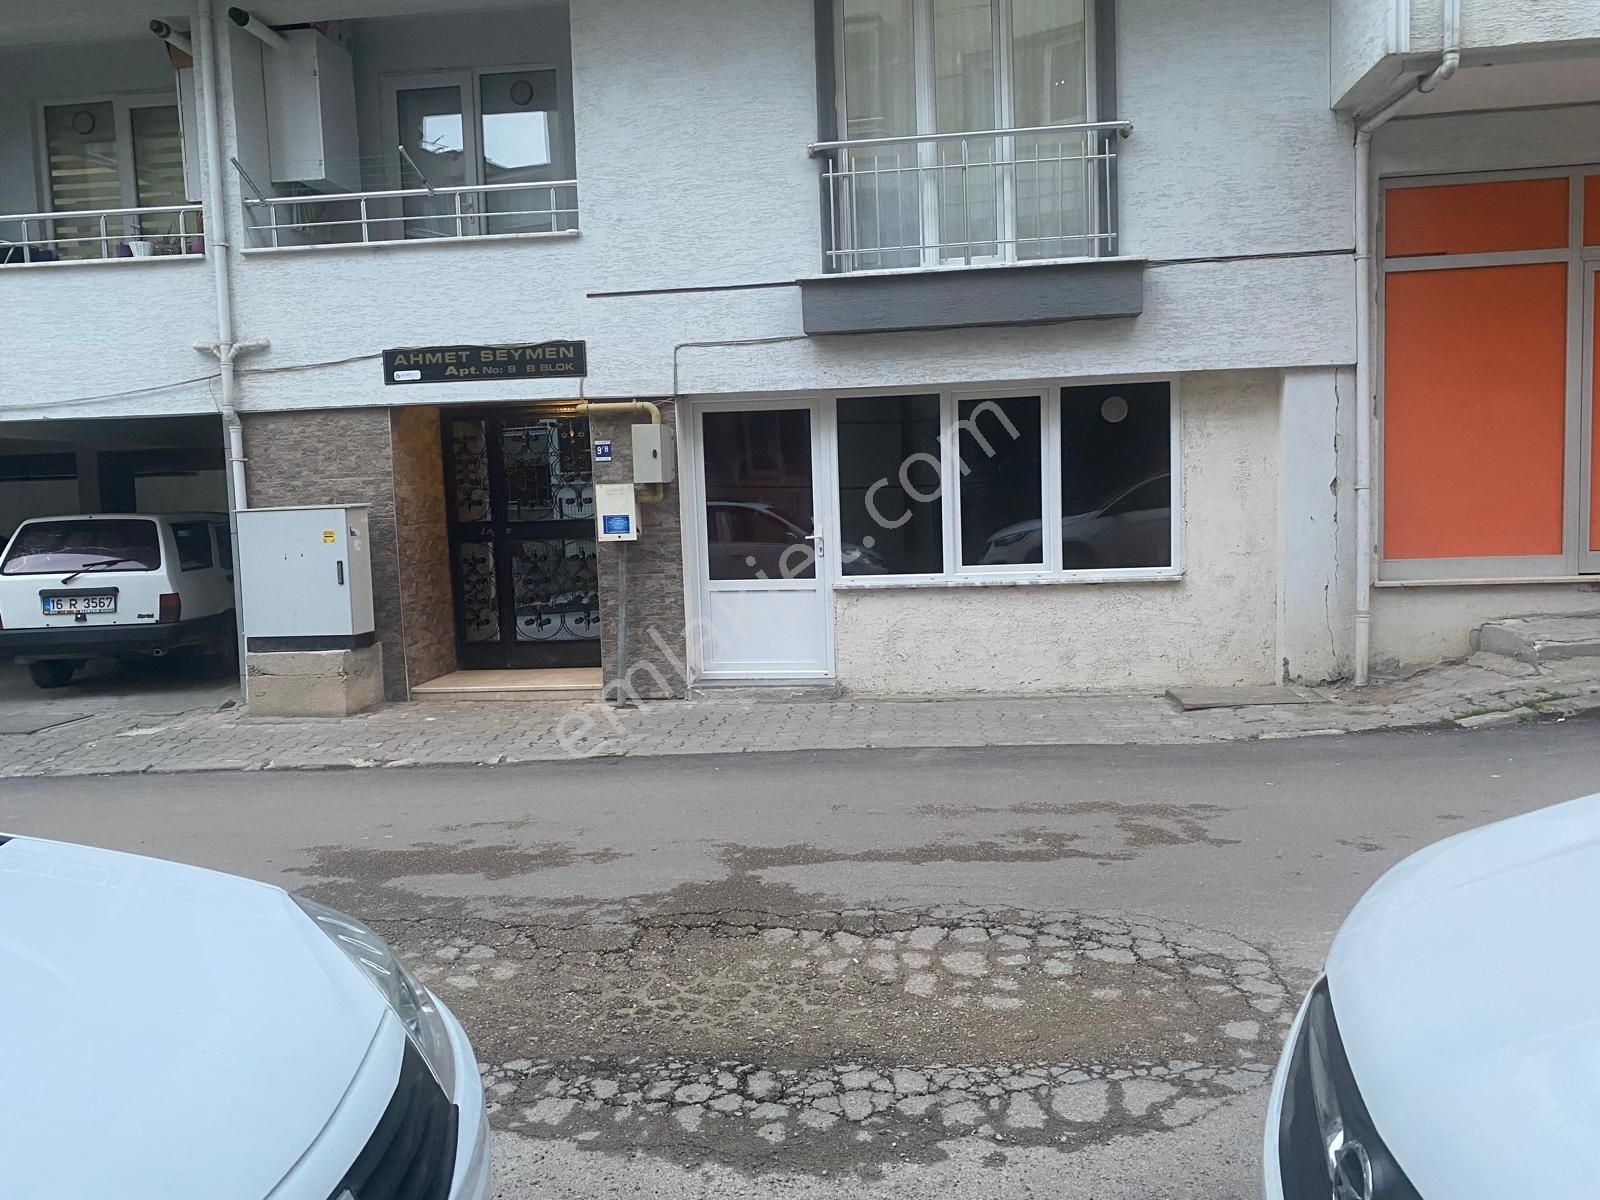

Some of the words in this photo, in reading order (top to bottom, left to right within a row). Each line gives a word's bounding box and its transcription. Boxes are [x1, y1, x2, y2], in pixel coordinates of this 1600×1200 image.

[393, 351, 470, 366] AHMET
[479, 346, 575, 362] SEYMEN
[444, 365, 480, 377] Apt.
[482, 366, 503, 375] No:
[507, 364, 516, 373] 9
[526, 363, 536, 373] B
[539, 362, 574, 372] BLOK
[51, 599, 63, 610] 16
[69, 598, 78, 609] R
[83, 597, 113, 609] 3567
